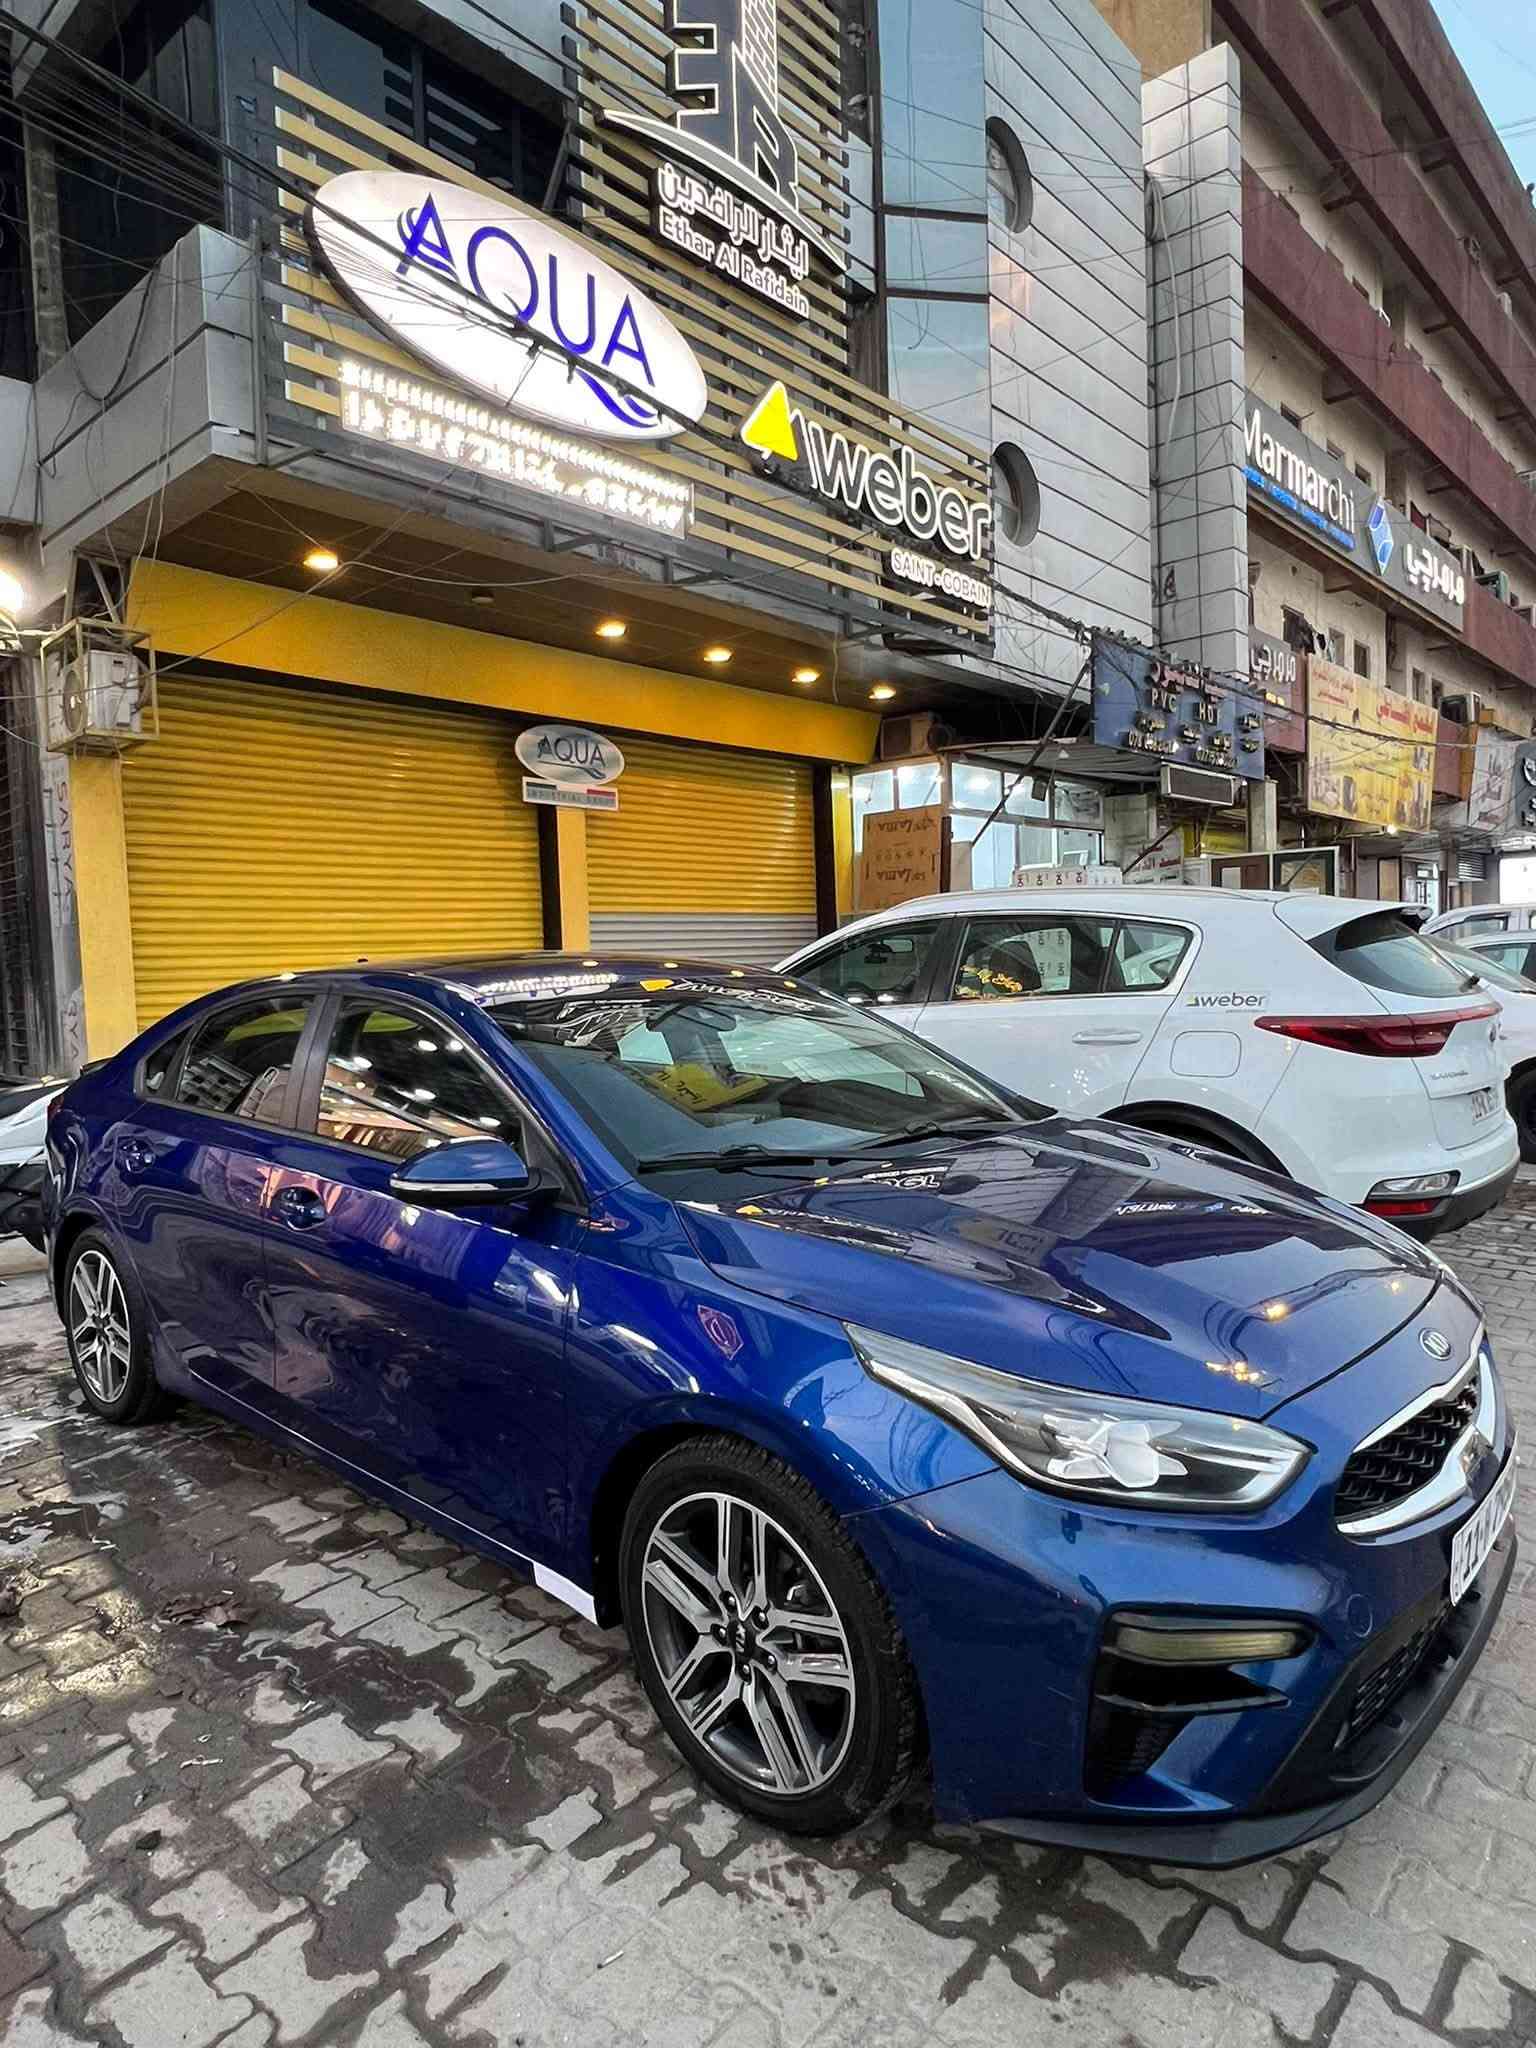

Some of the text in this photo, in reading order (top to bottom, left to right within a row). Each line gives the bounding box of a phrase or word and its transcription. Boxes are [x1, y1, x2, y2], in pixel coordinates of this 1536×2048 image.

[658, 161, 760, 247] الرافدين
[396, 191, 655, 387] AQUA
[658, 205, 809, 319] Ethar Al Rafidain
[808, 421, 992, 560] weber
[1151, 687, 1177, 713] PVC
[536, 735, 607, 768] AQUA
[1200, 992, 1267, 1007] weber
